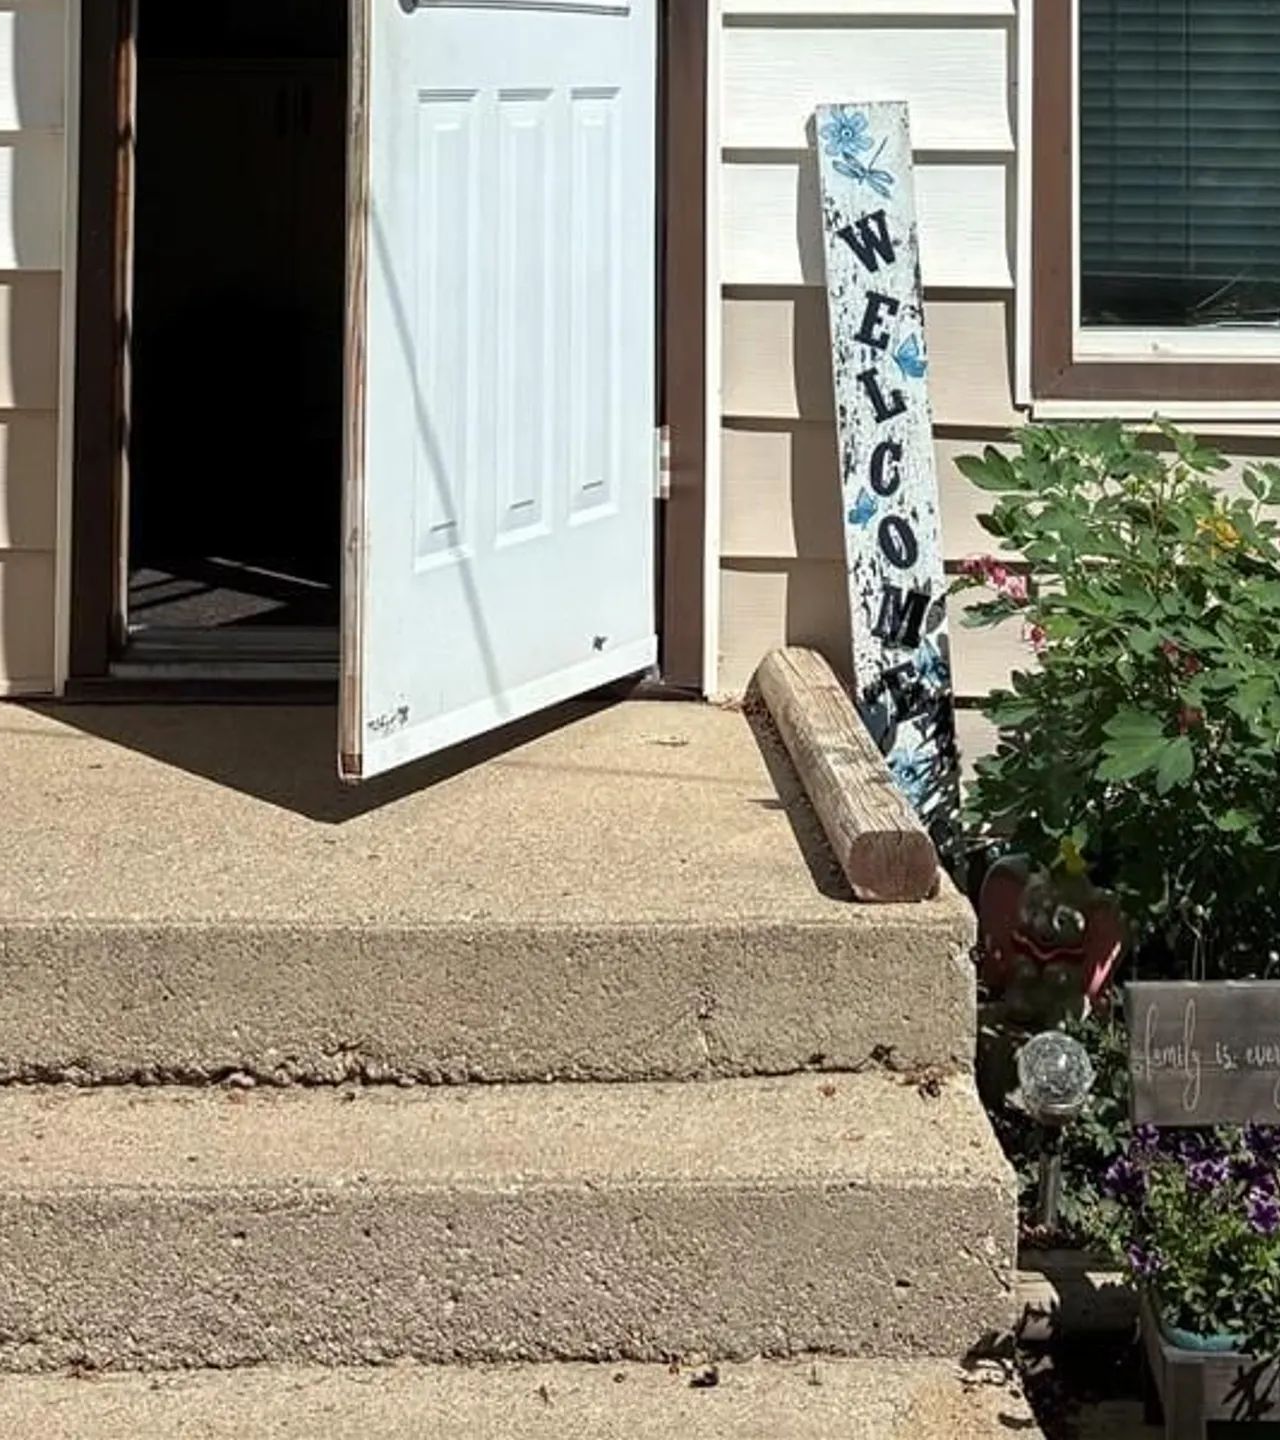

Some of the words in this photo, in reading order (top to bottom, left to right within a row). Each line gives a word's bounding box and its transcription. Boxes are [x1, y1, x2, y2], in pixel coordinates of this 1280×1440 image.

[838, 207, 932, 724] WELCOME
[1143, 997, 1201, 1112] family
[1215, 1041, 1238, 1070] is
